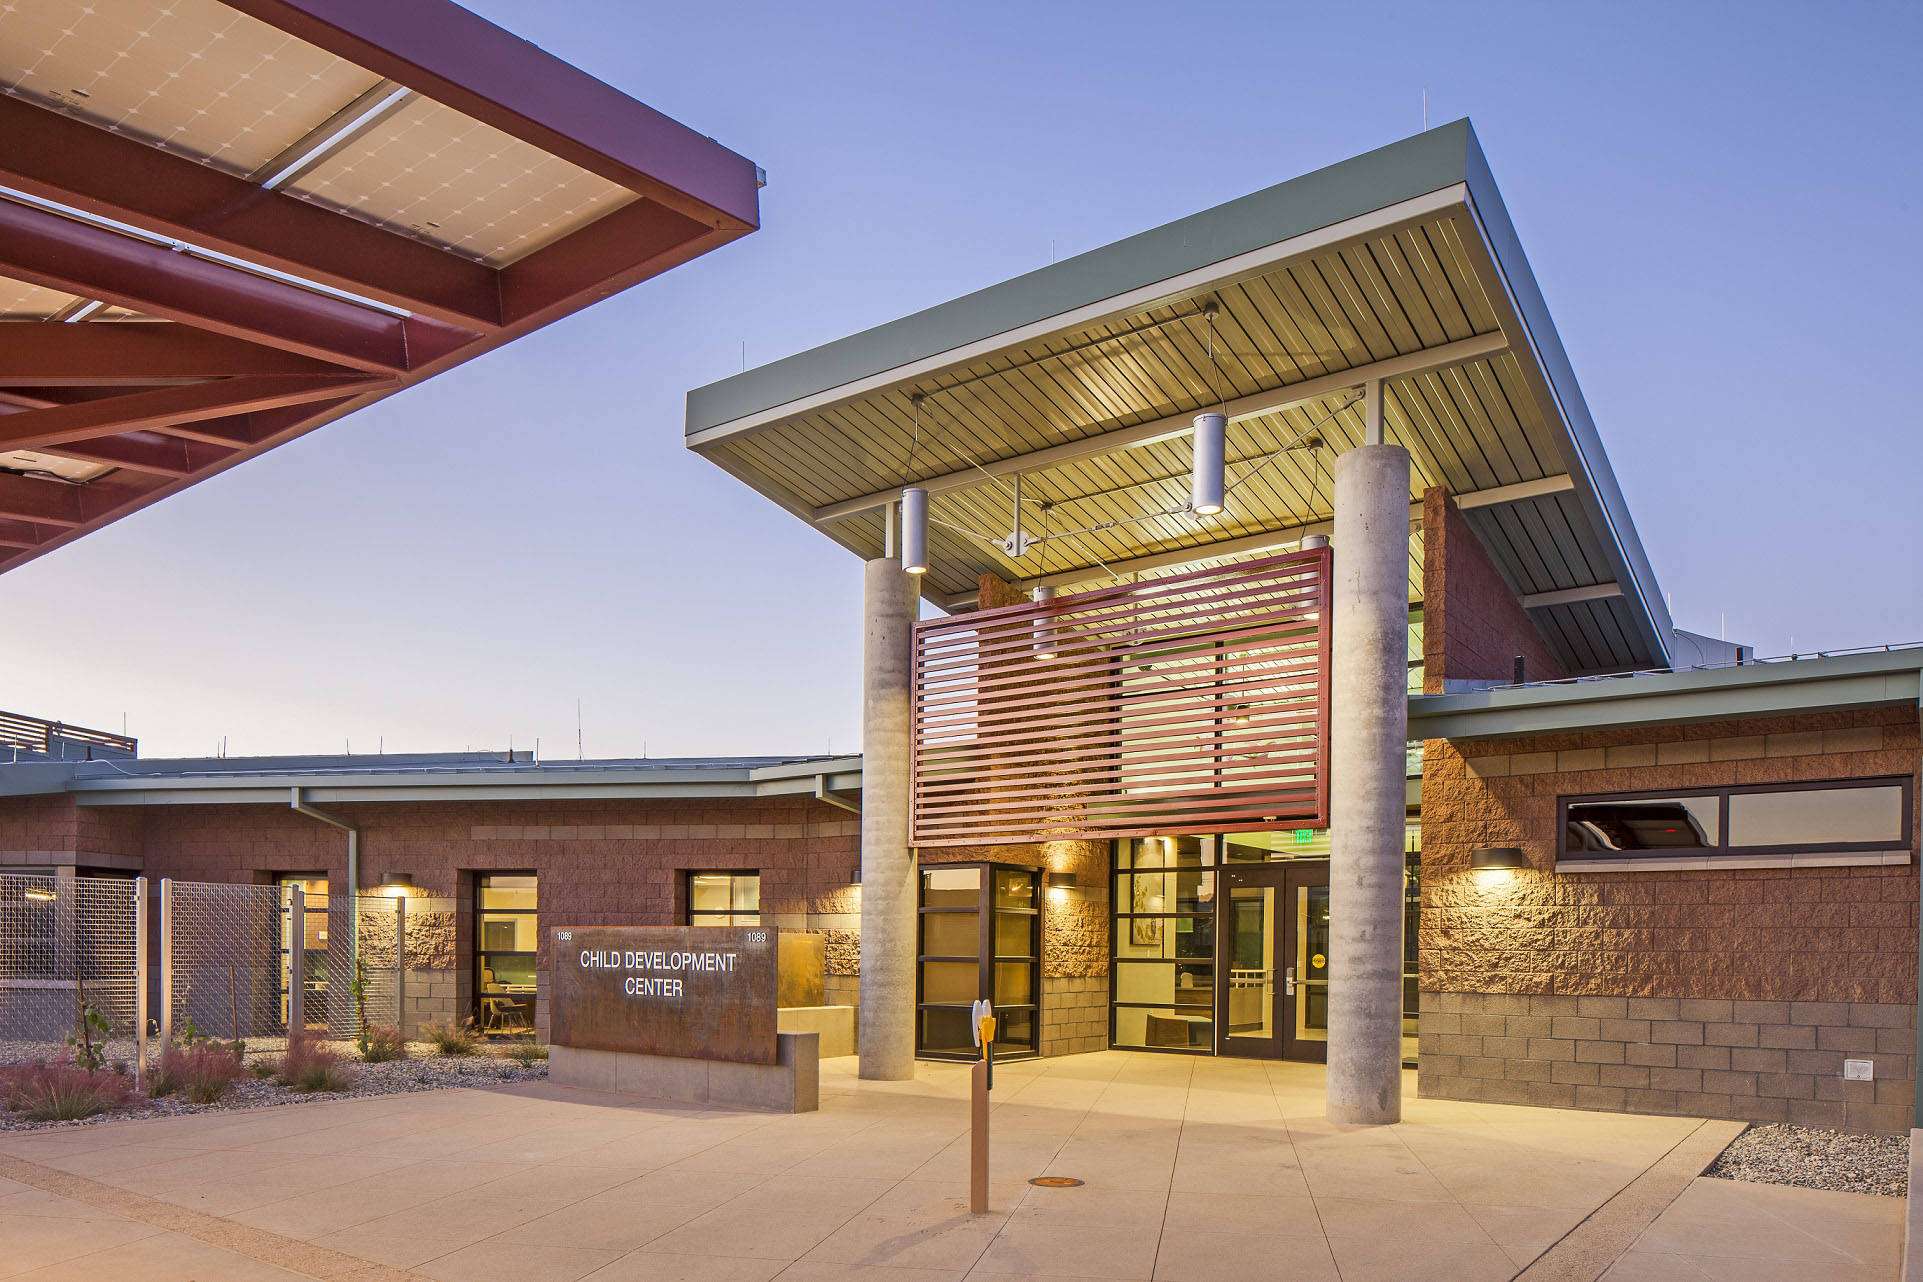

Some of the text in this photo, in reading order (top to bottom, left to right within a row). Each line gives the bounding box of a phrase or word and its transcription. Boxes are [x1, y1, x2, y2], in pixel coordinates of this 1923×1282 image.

[557, 932, 572, 941] 1089
[747, 932, 767, 943] 1089
[580, 950, 737, 972] CHILD DEVELOPMENT
[624, 977, 683, 997] CENTER
